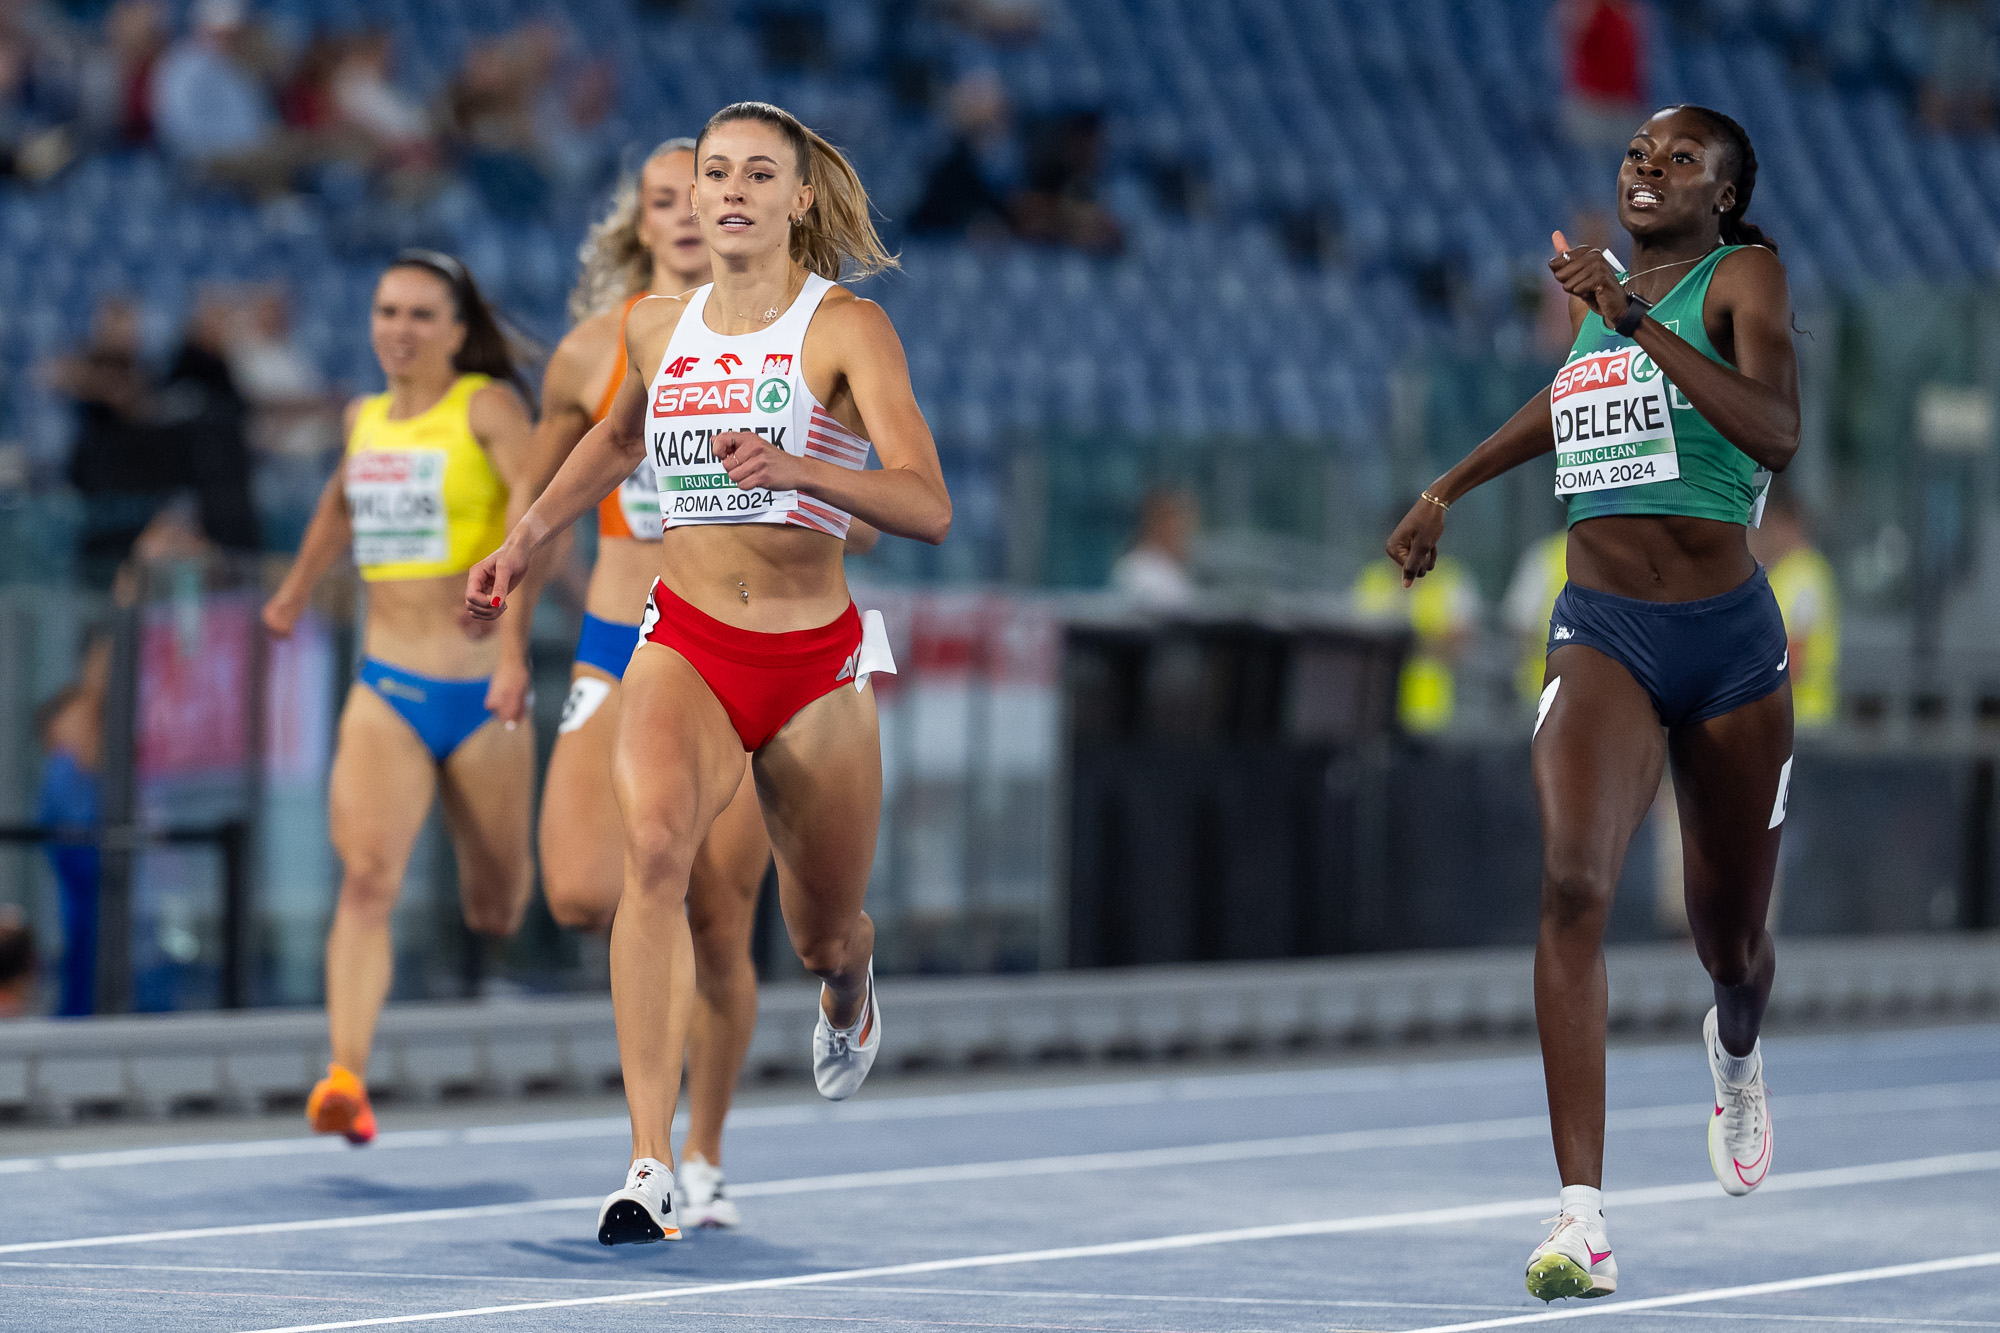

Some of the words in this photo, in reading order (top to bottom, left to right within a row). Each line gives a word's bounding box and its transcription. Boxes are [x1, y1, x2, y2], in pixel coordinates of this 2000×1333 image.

[664, 356, 700, 378] 4F
[1553, 357, 1627, 398] SPAR
[655, 383, 751, 413] SPAR
[1559, 454, 1564, 466] I
[1566, 451, 1594, 466] RUN
[680, 477, 684, 489] I
[685, 475, 710, 489] RUN
[1609, 461, 1657, 483] 2024
[674, 494, 723, 513] ROMA
[726, 490, 776, 511] 2024
